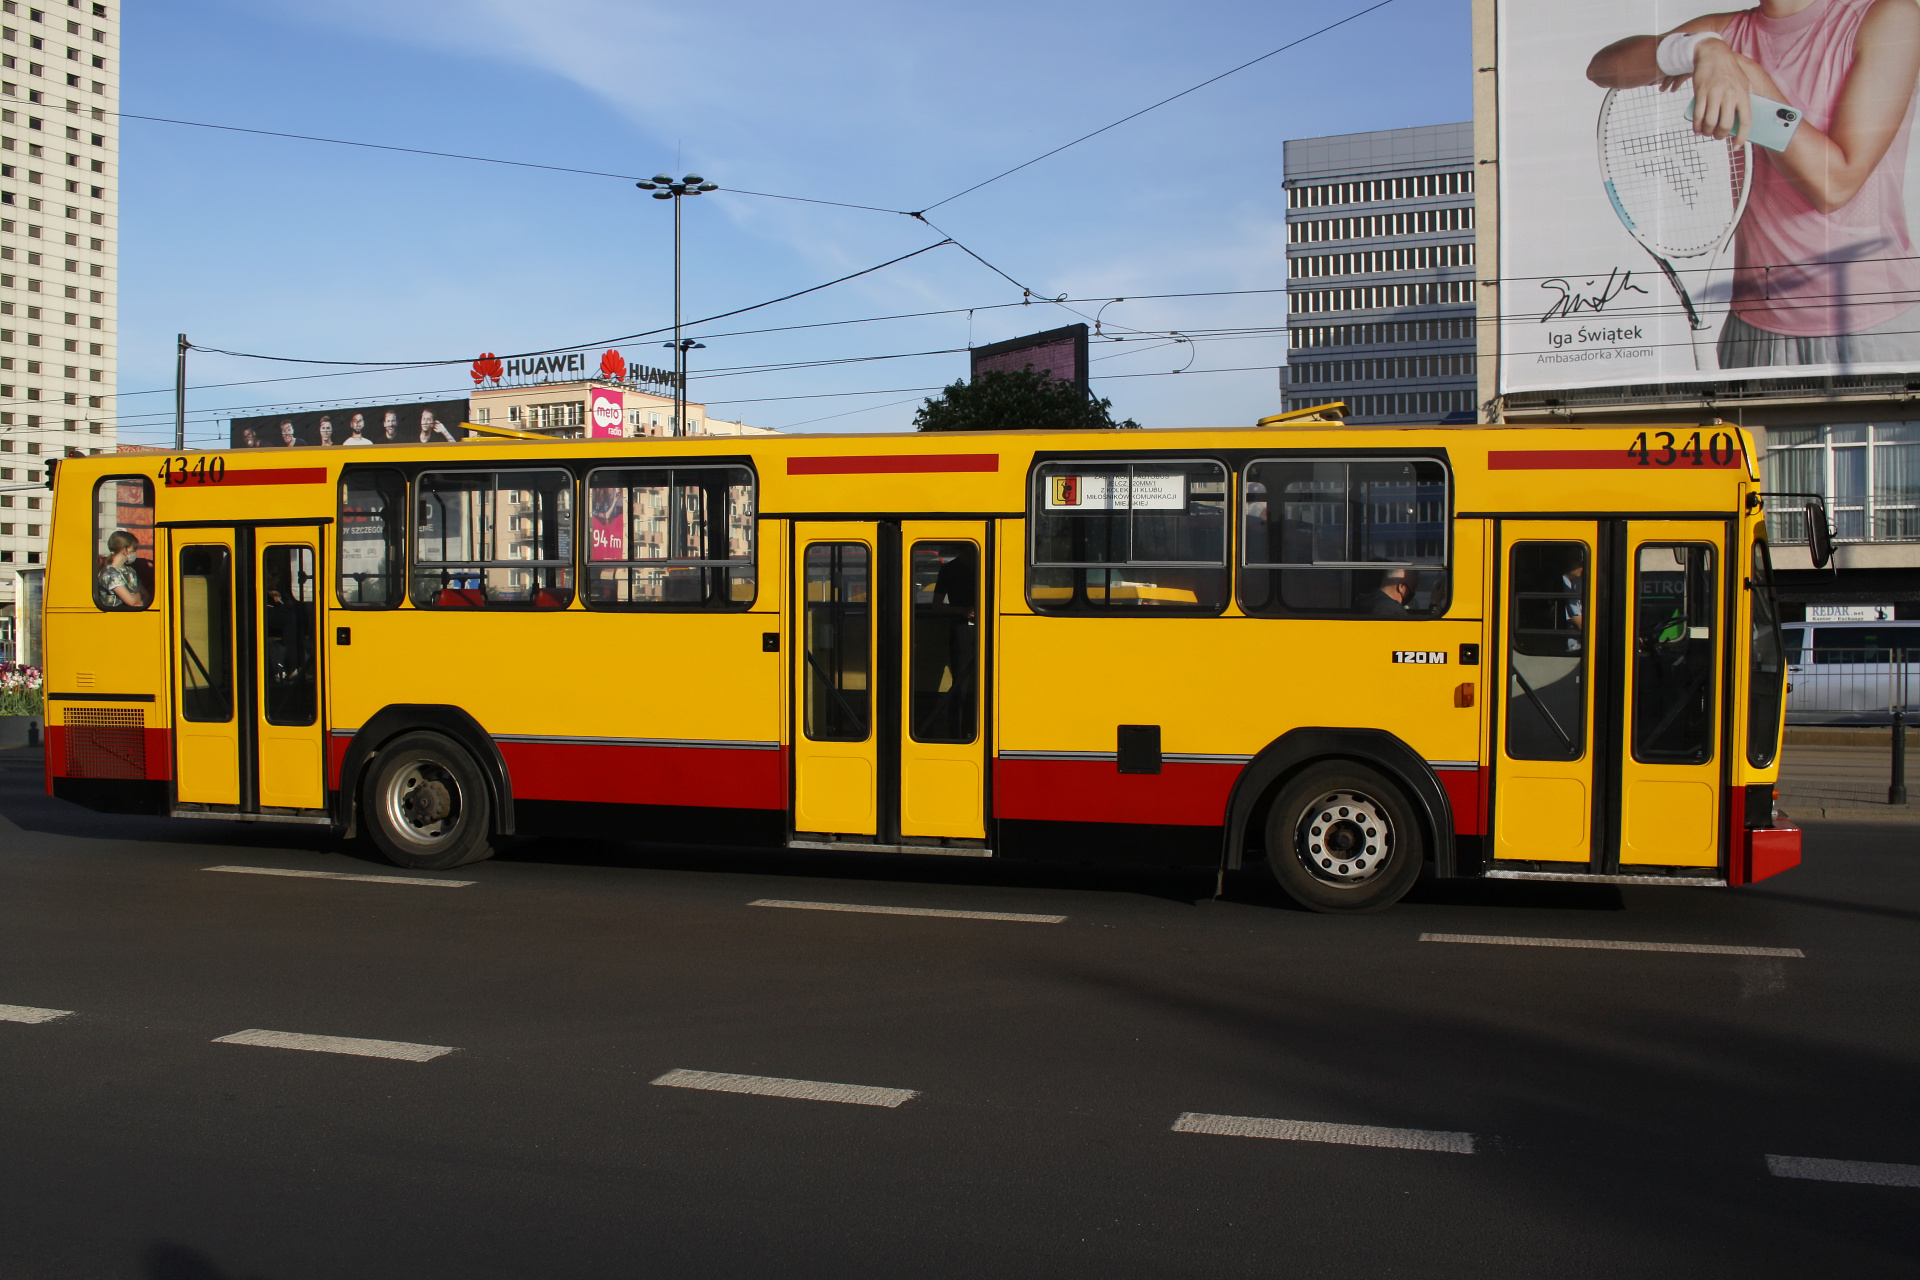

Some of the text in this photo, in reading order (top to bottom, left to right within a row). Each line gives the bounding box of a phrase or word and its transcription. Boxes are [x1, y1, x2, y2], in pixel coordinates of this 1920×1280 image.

[1548, 325, 1643, 349] Iga Świątek
[508, 353, 584, 377] HUAWEI
[1537, 347, 1654, 364] Ambasadorka Xiaomi
[608, 427, 622, 436] radio
[1627, 431, 1734, 466] 4340
[158, 456, 225, 485] 4340
[593, 529, 621, 549] 94 fm
[1812, 605, 1849, 616] REDAR
[1395, 651, 1445, 664] 120M
